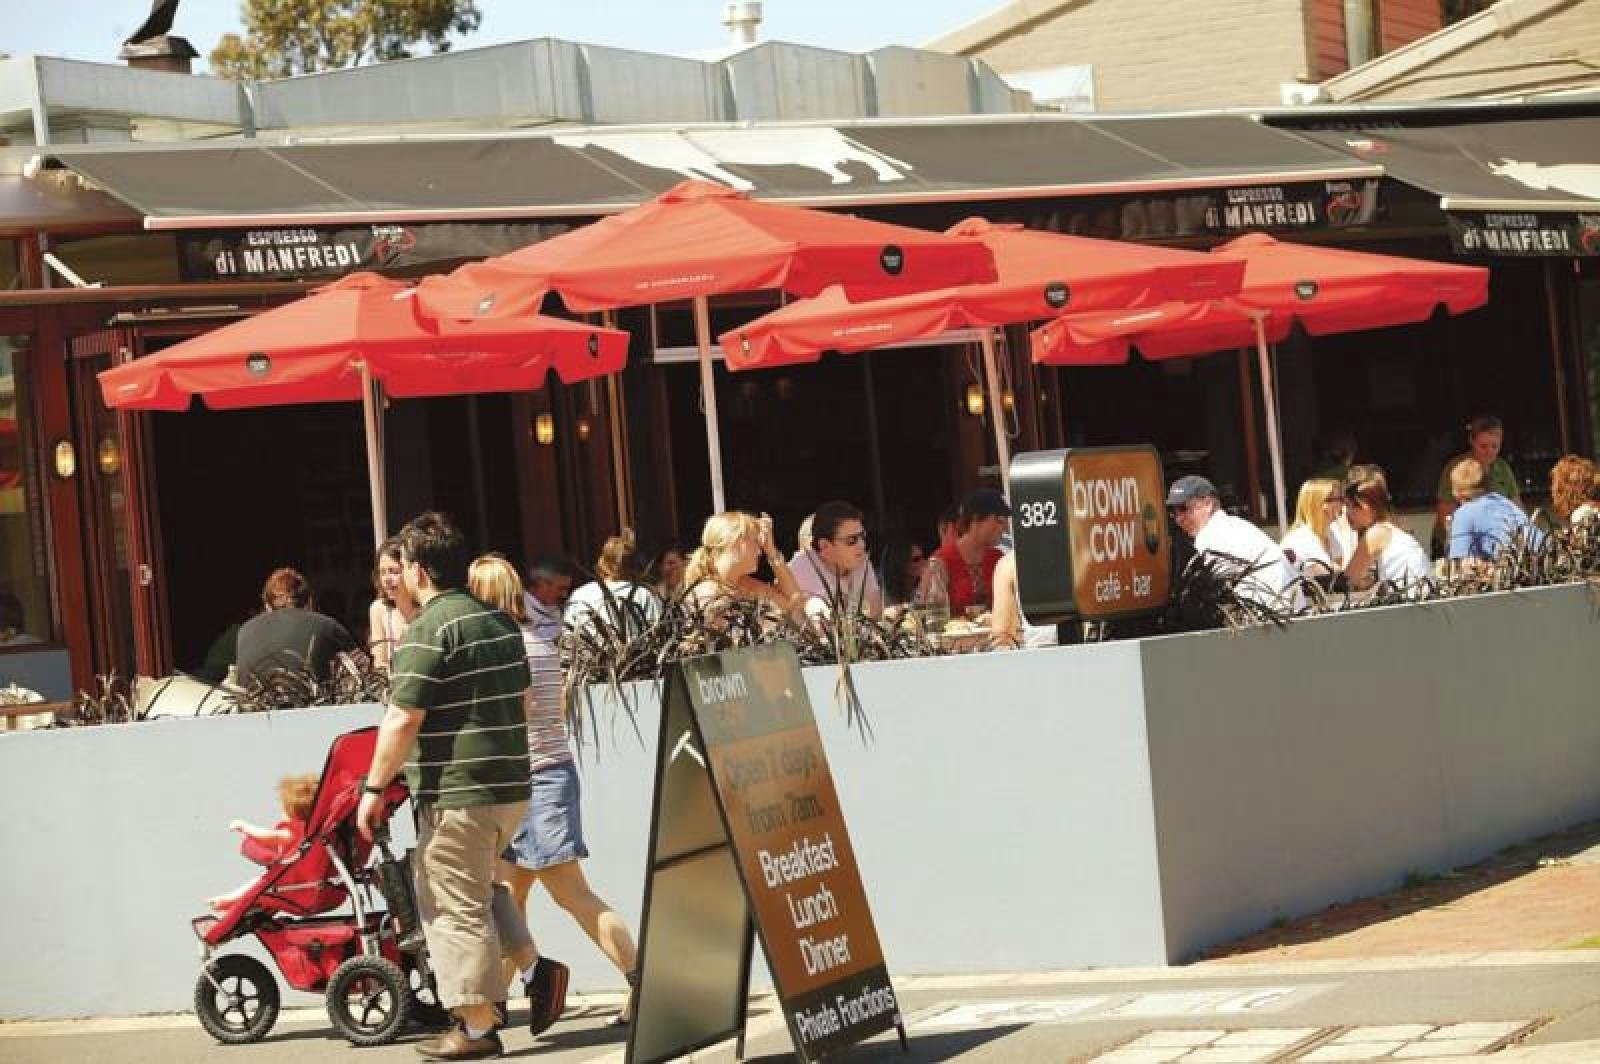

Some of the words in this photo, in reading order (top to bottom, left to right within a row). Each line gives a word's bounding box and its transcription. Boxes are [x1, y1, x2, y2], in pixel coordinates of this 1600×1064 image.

[1224, 201, 1317, 229] MANFREDI
[215, 251, 237, 274] di
[244, 242, 361, 273] MANFREDI
[1483, 229, 1569, 251] MANFREDI
[1069, 466, 1141, 519] brown
[1019, 501, 1057, 528] 382
[1089, 519, 1136, 563] cow
[1095, 569, 1121, 603] café
[1132, 567, 1152, 597] bar
[695, 671, 749, 705] brown
[757, 832, 839, 888] Breakfast
[785, 882, 839, 929] Lunch
[799, 933, 851, 977] Dinner
[795, 1003, 841, 1043] Private
[836, 985, 895, 1026] Functions
